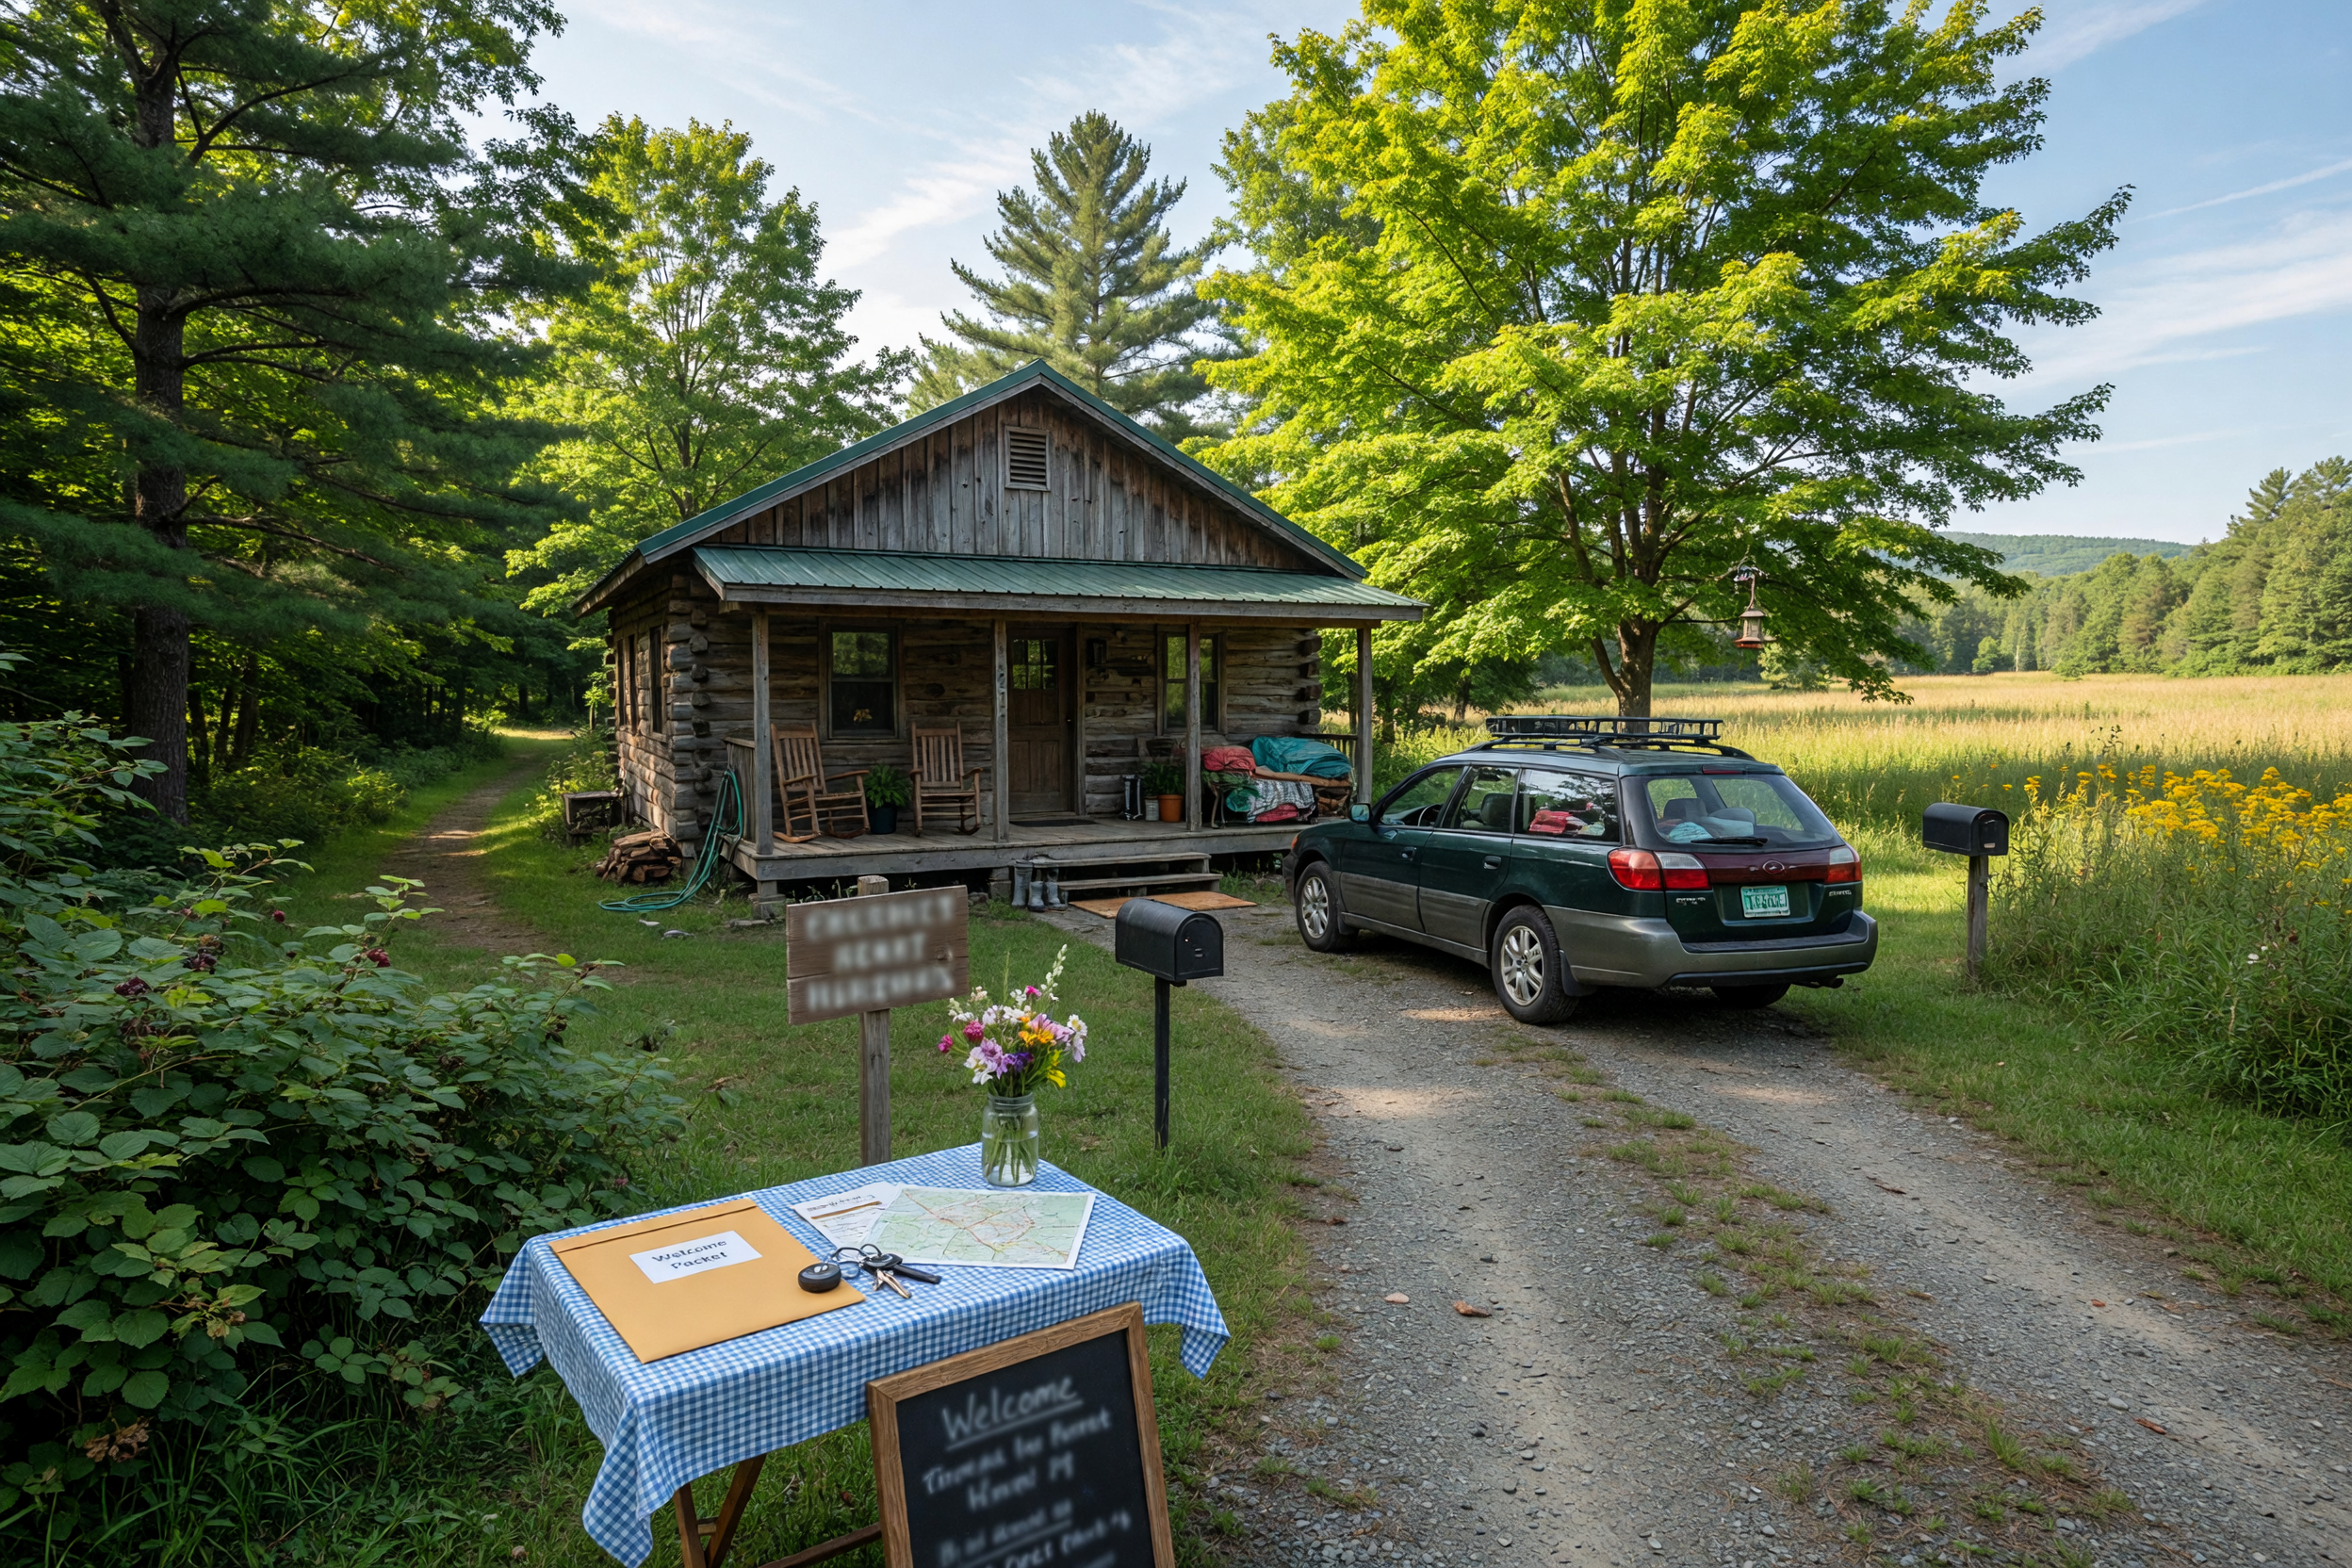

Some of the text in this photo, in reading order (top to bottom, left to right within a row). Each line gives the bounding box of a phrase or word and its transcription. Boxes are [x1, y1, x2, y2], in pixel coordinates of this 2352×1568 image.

[651, 1240, 727, 1262] Welcome
[670, 1251, 727, 1269] Packet
[942, 1376, 1078, 1442] Welcome
